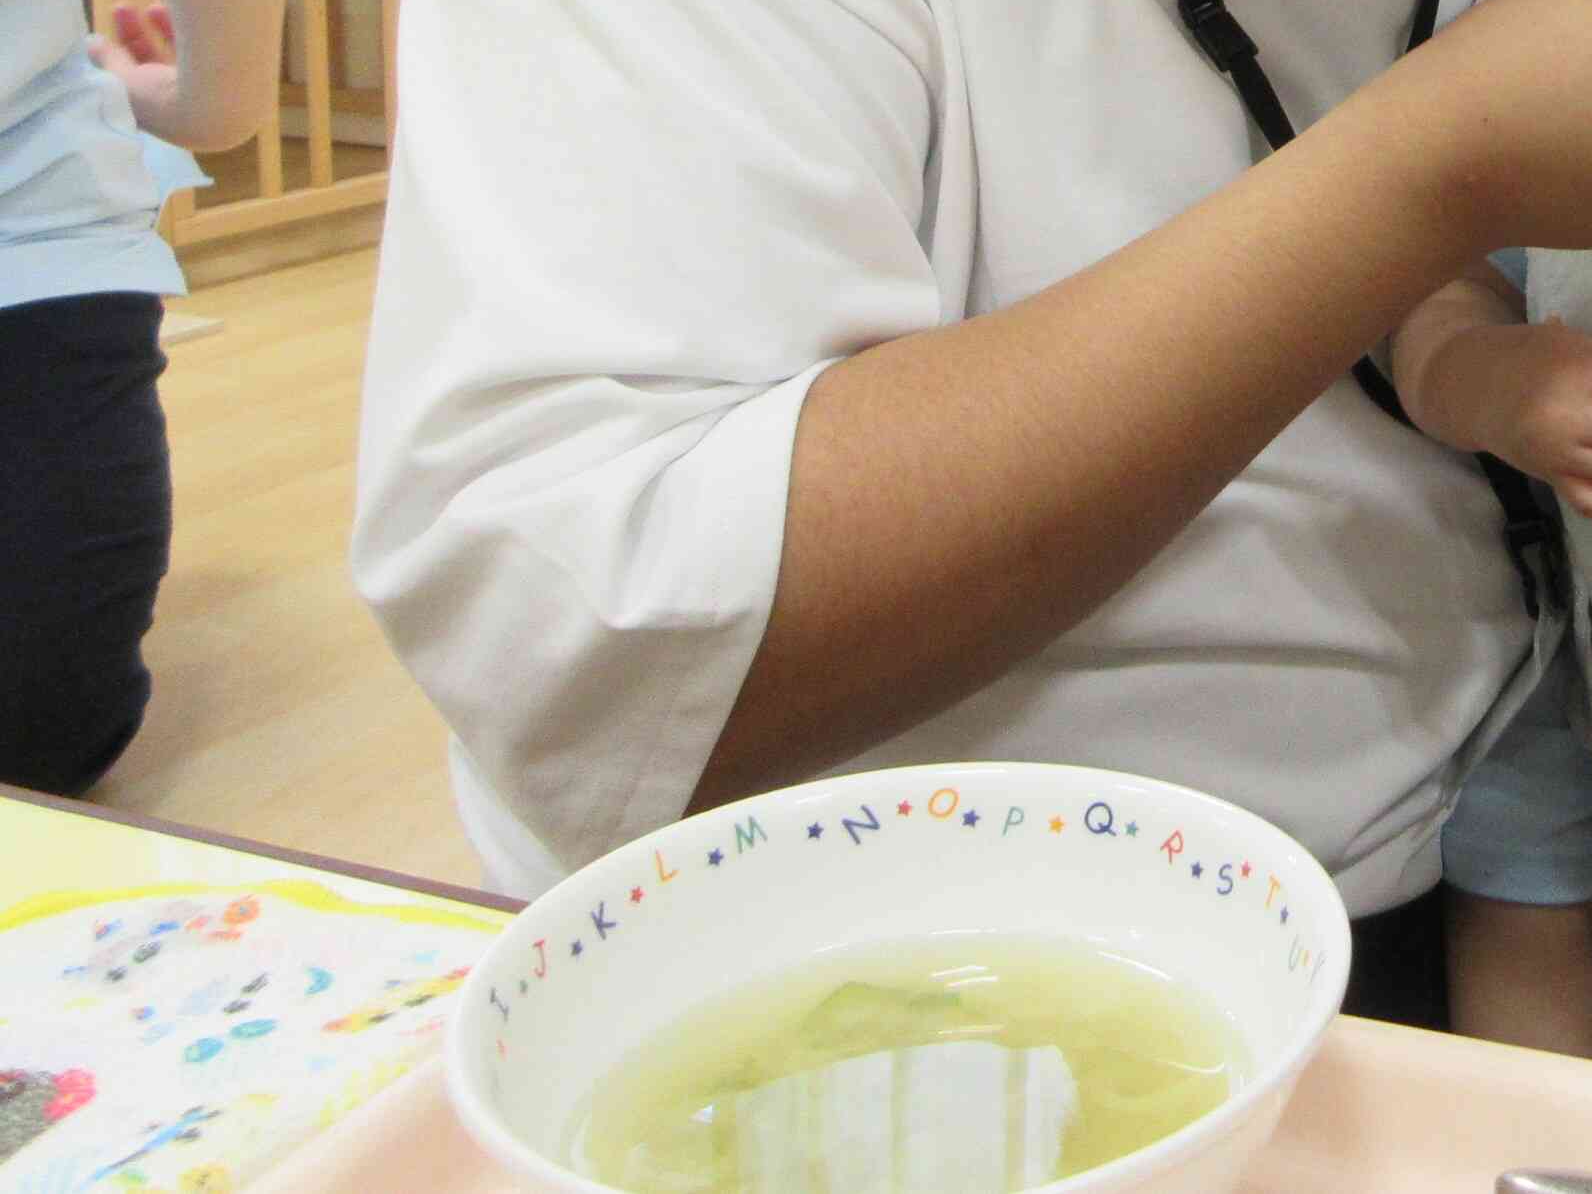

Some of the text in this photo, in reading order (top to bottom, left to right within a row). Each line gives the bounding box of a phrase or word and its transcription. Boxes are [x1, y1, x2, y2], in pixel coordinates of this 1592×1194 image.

[532, 938, 547, 979] J
[590, 900, 619, 940] K
[655, 848, 681, 883] L
[734, 815, 768, 854] M
[841, 804, 881, 845] N
[928, 787, 960, 820] O
[1002, 806, 1026, 837] P
[1084, 801, 1118, 837] Q
[1159, 829, 1185, 865] R
[1217, 863, 1234, 896] S
[1266, 873, 1282, 910] T
